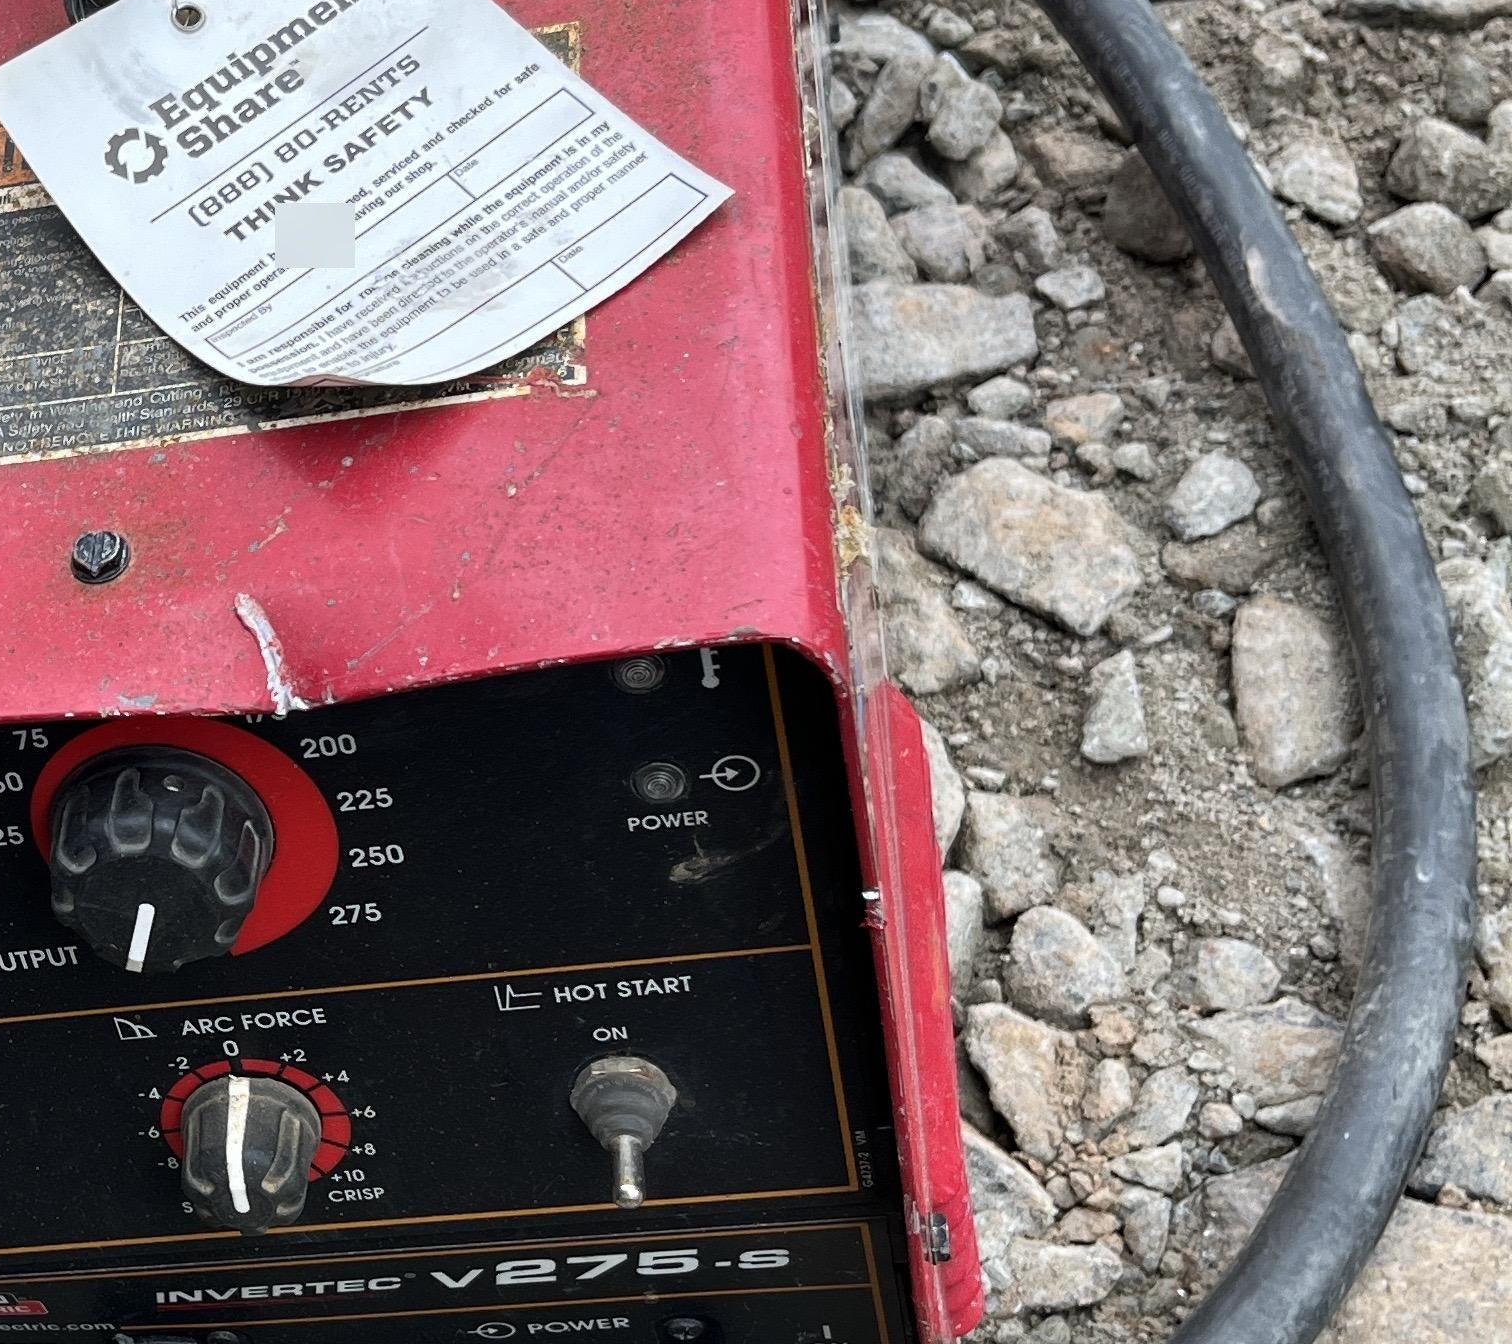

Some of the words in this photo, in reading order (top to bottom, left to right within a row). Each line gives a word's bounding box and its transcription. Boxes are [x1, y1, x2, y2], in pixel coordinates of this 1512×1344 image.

[187, 161, 274, 227] (888)
[273, 53, 420, 163] 80-RENTS
[222, 168, 325, 242] THINK
[322, 85, 433, 173] SAFETY
[453, 156, 480, 179] Date
[178, 303, 206, 322] This
[207, 258, 268, 305] equipment
[371, 148, 420, 188] serviced
[421, 131, 445, 152] and
[445, 96, 494, 134] checked
[493, 82, 512, 98] for
[513, 63, 540, 84] safe
[191, 314, 214, 332] and
[213, 288, 251, 319] proper
[384, 180, 404, 198] our
[404, 161, 437, 183] shop.
[267, 314, 336, 356] responsible
[335, 300, 354, 317] for
[400, 236, 452, 270] cleaning
[449, 213, 483, 237] while
[481, 198, 504, 215] the
[503, 153, 563, 200] equipment
[561, 145, 577, 157] is
[574, 135, 591, 147] in
[590, 120, 610, 137] my
[325, 316, 355, 342] have
[464, 233, 482, 247] on
[480, 218, 502, 236] the
[500, 191, 541, 222] correct
[539, 155, 591, 194] operation
[589, 143, 604, 158] of
[601, 131, 623, 147] the
[342, 323, 370, 346] have
[370, 304, 397, 330] been
[454, 254, 474, 273] the
[566, 164, 603, 194] and/or
[601, 140, 637, 168] safety
[359, 335, 379, 351] the
[378, 295, 437, 339] equipment
[450, 277, 468, 289] be
[494, 244, 512, 262] in
[509, 238, 524, 253] a
[521, 225, 547, 244] safe
[546, 207, 570, 227] and
[569, 181, 606, 212] proper
[606, 151, 649, 184] manner
[555, 243, 584, 265] Date
[256, 300, 275, 317] By
[12, 727, 49, 750] 75
[299, 733, 357, 759] 200
[336, 787, 393, 812] 225
[627, 811, 708, 831] POWER
[348, 844, 404, 868] 250
[328, 902, 382, 925] 275
[554, 984, 606, 1003] HOT
[617, 976, 691, 997] START
[181, 1016, 235, 1035] ARC
[240, 1007, 327, 1030] FORCE
[593, 1027, 627, 1041] ON
[222, 1039, 239, 1056] 0
[279, 1048, 307, 1062] +2
[168, 1056, 190, 1070] -2
[321, 1069, 350, 1082] +4
[138, 1087, 161, 1099] -4
[351, 1105, 376, 1118] +6
[138, 1125, 160, 1139] -6
[351, 1142, 376, 1156] +8
[330, 1168, 365, 1182] +10
[328, 1186, 385, 1202] CRISP
[157, 1278, 401, 1303] INVERTEC
[429, 1246, 789, 1291] V275-S
[528, 1318, 629, 1333] POWER
